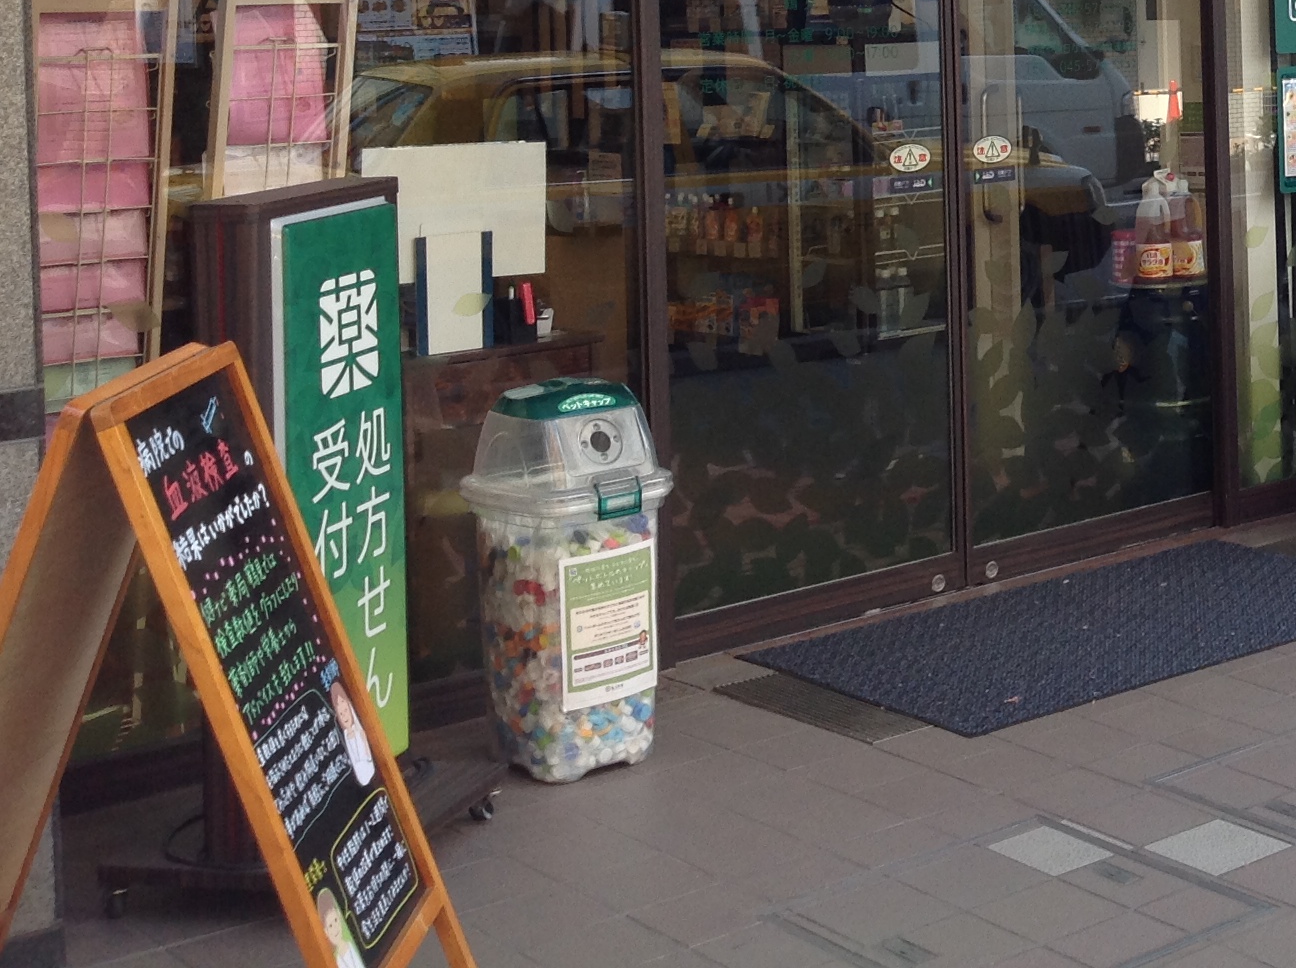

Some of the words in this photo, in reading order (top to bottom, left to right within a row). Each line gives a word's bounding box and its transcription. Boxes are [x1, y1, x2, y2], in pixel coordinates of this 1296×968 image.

[319, 269, 379, 399] 薬
[136, 425, 186, 478] 病院での
[311, 418, 353, 579] 受付
[354, 406, 393, 709] 処方せん
